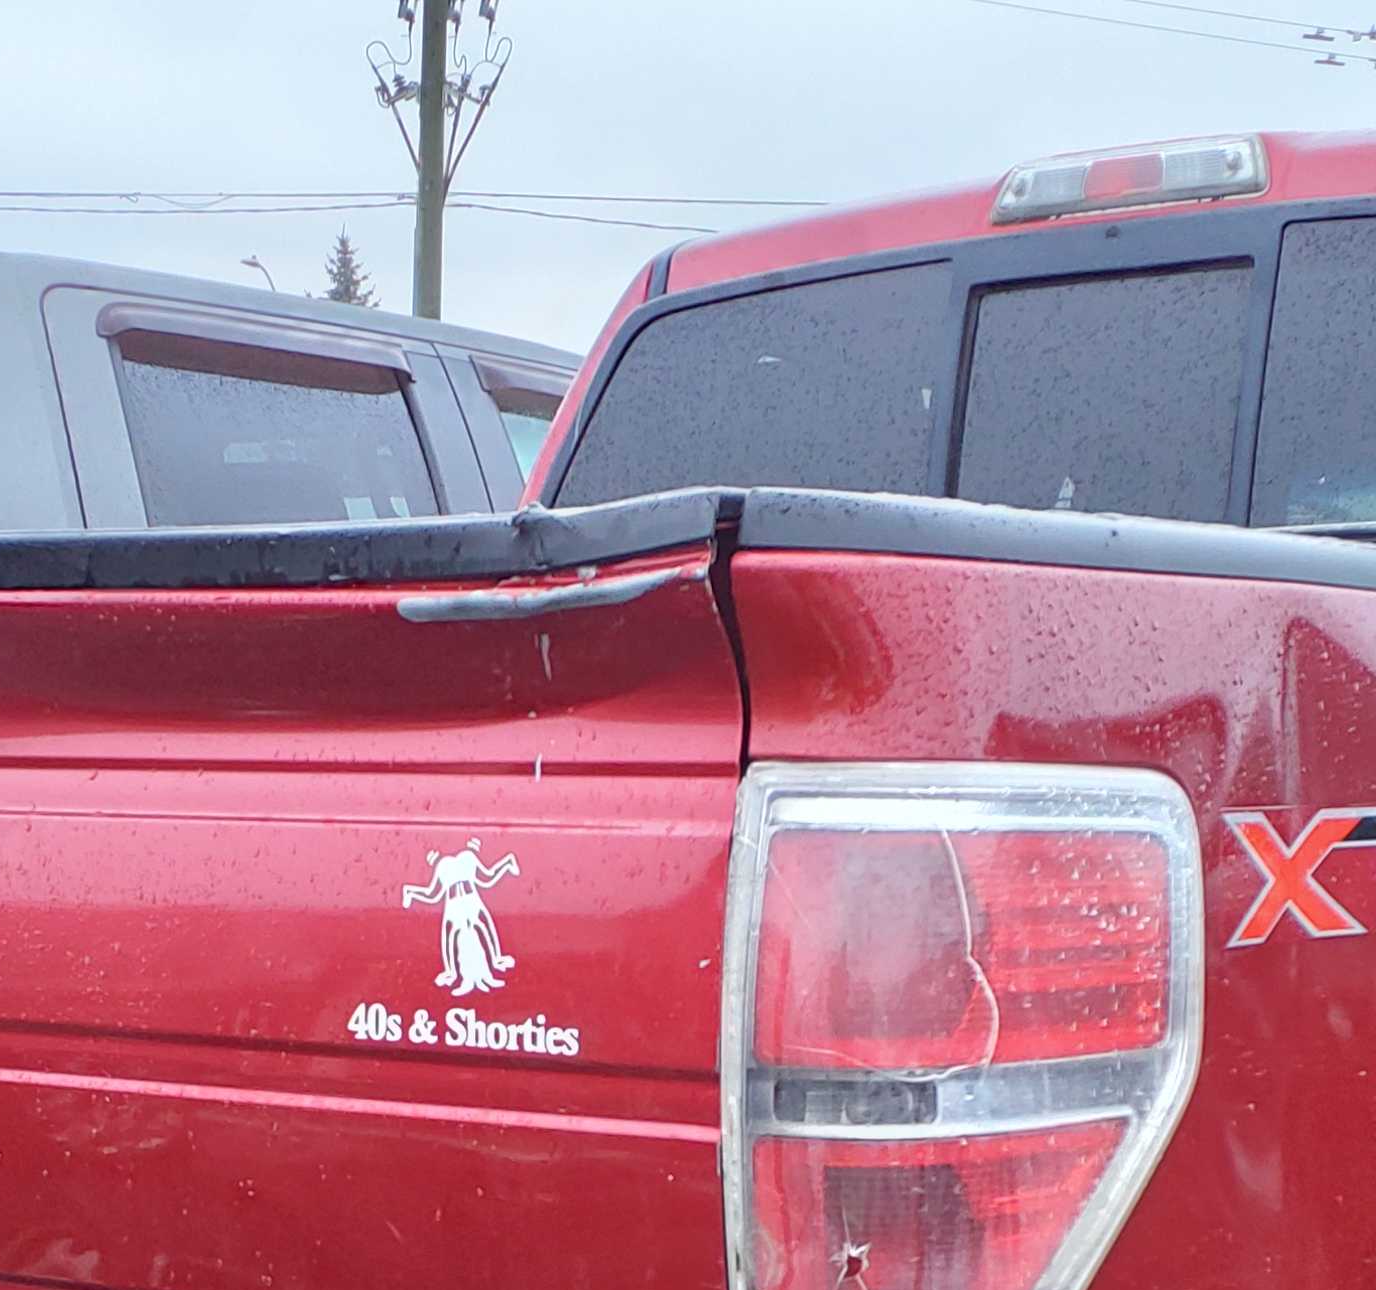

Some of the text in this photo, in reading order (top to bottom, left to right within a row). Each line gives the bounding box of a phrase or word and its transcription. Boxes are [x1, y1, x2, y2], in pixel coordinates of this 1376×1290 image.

[347, 1002, 580, 1056] 40s & Shorties
